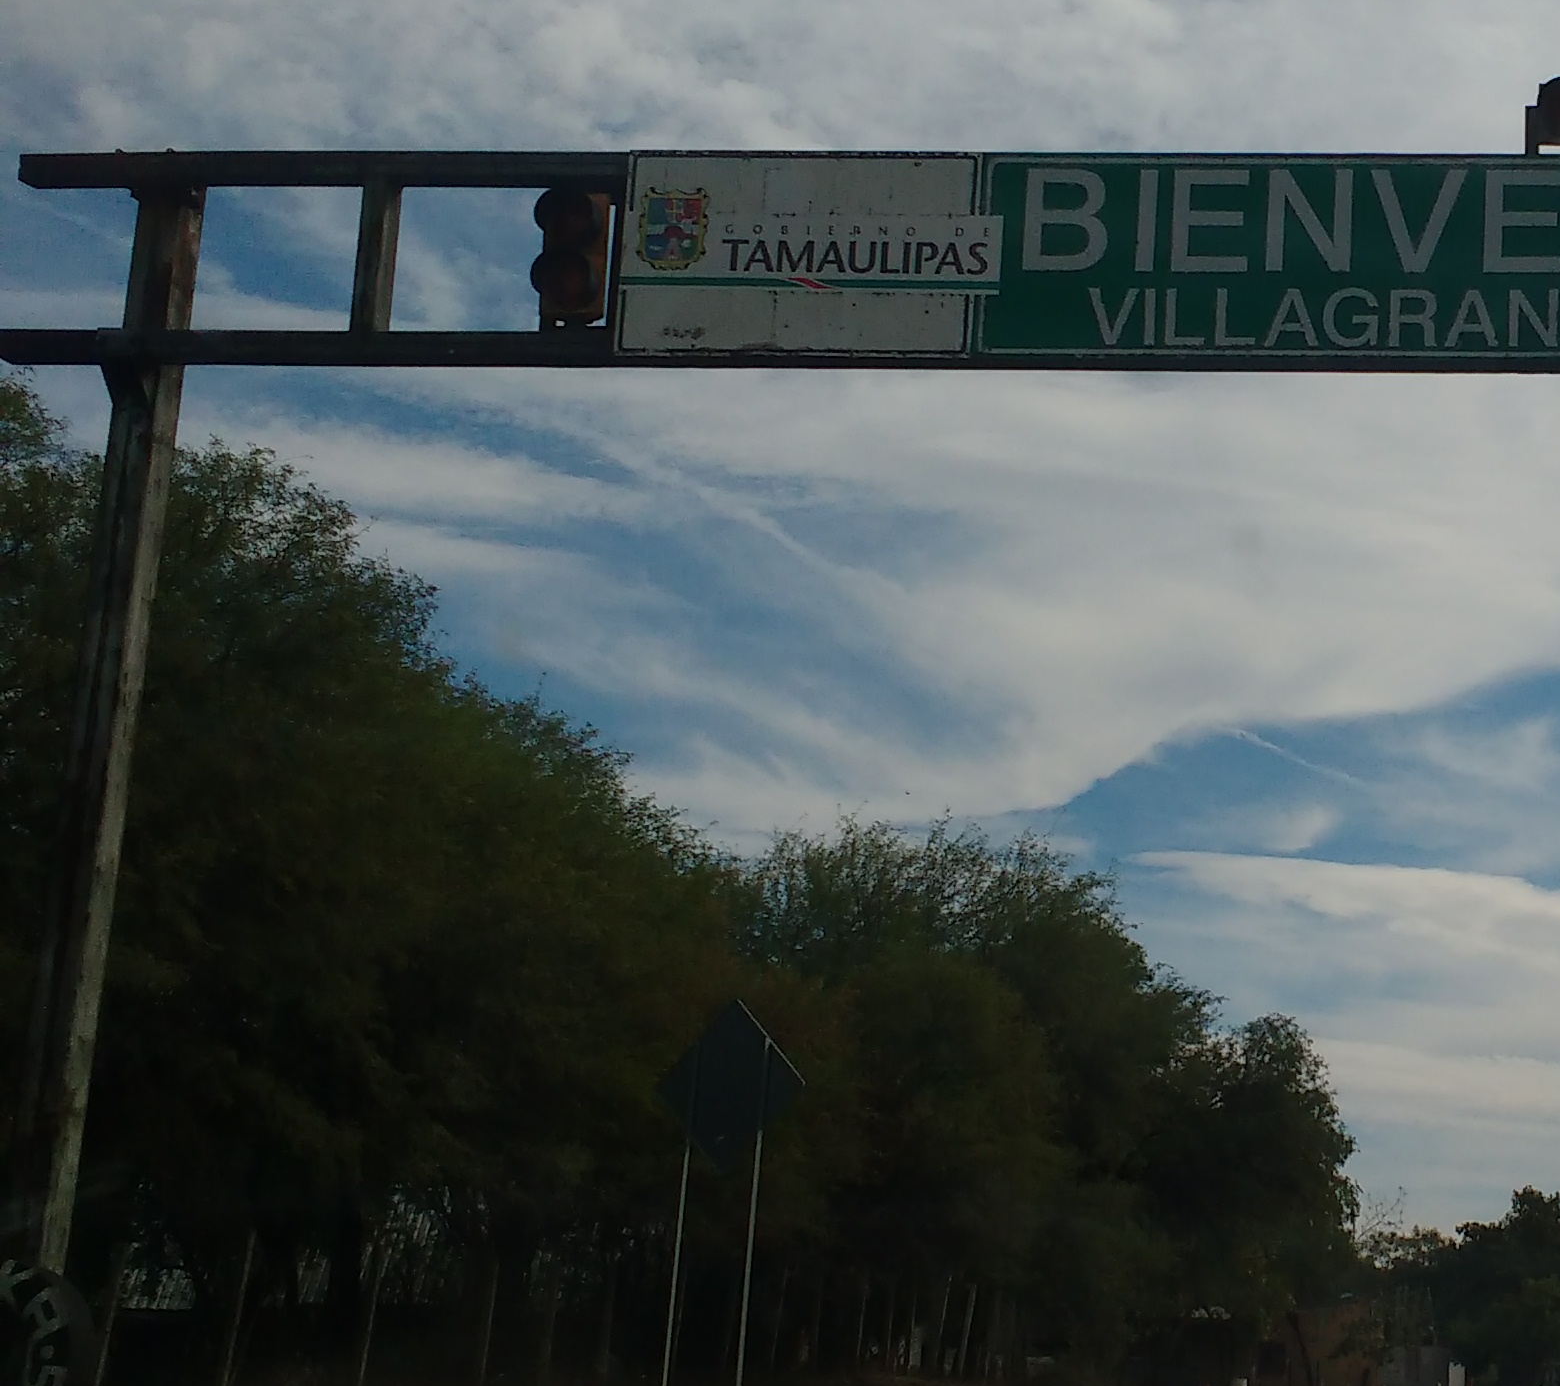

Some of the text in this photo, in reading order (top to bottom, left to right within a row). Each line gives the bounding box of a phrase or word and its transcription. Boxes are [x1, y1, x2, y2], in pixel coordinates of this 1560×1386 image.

[726, 223, 990, 237] GOBIERNO DE
[723, 239, 988, 275] TAMAULIPAS
[1088, 286, 1560, 348] VILLAGRAN
